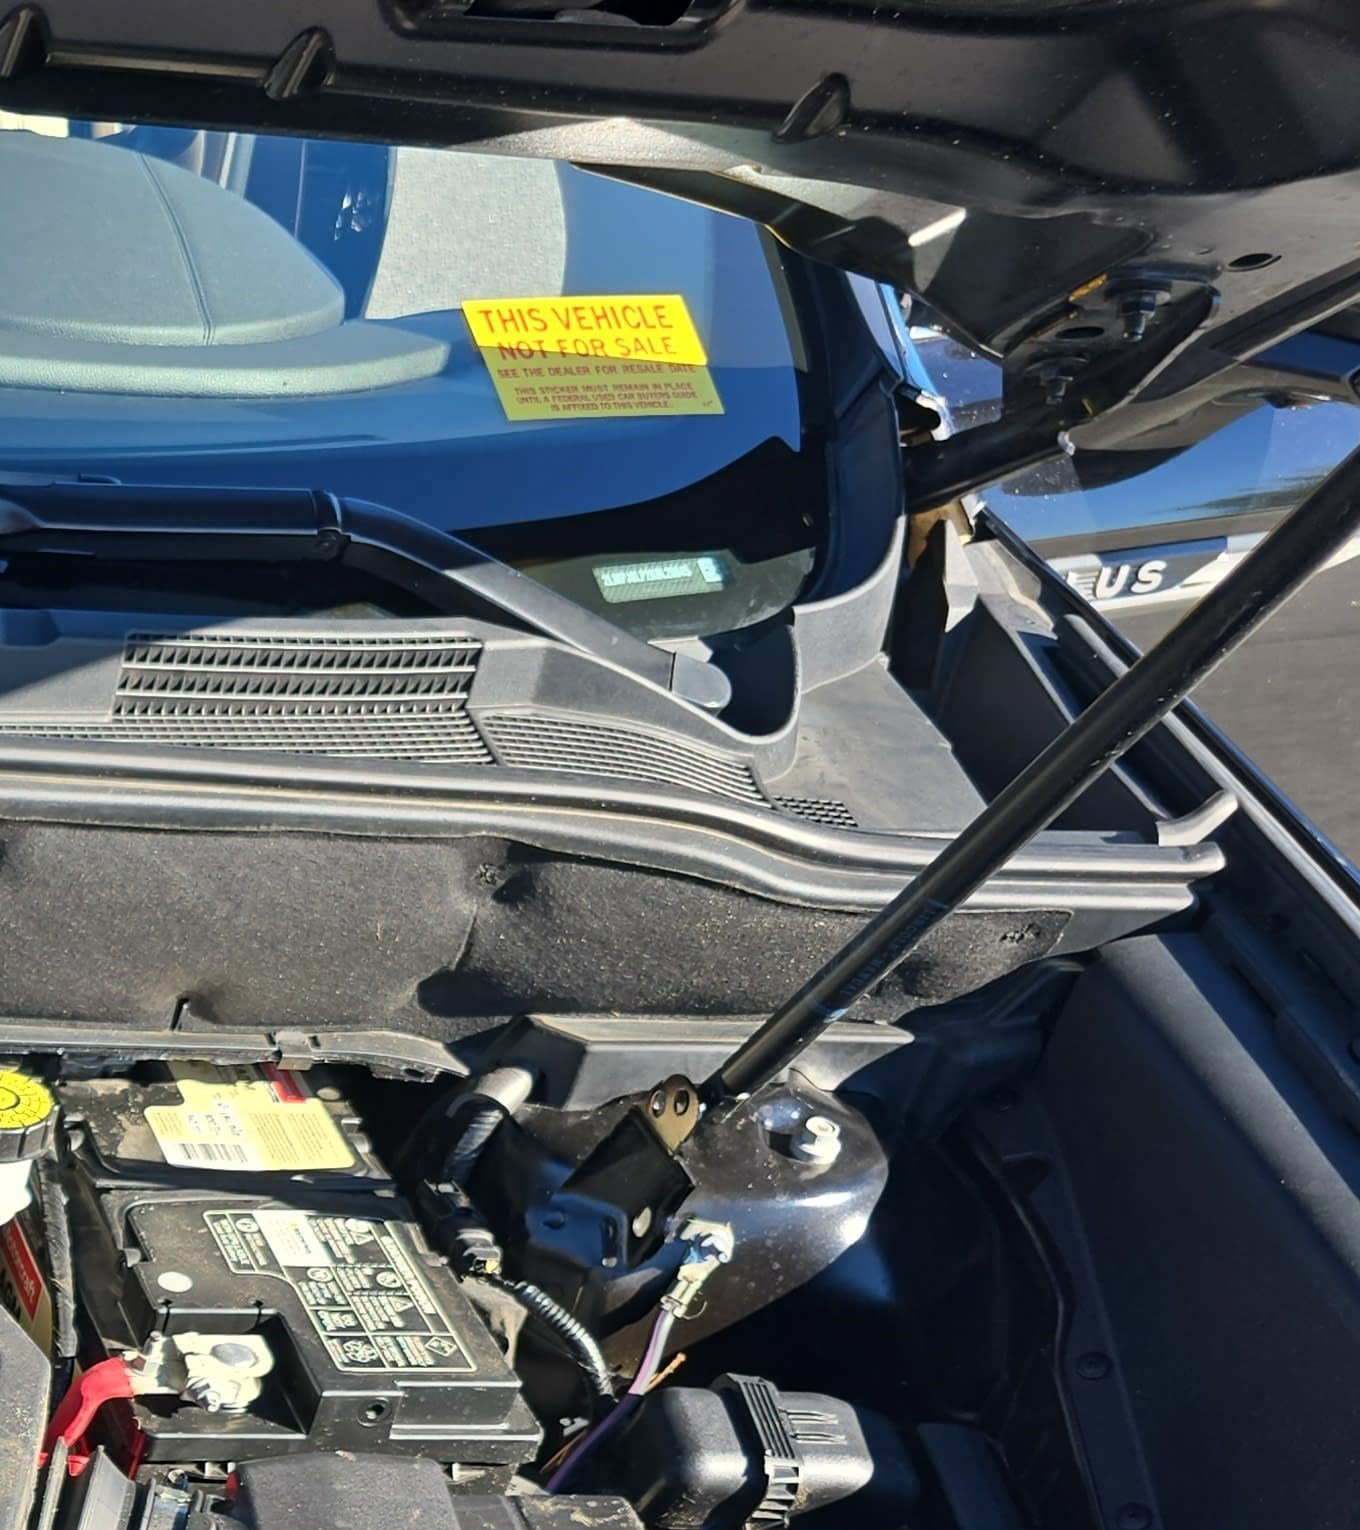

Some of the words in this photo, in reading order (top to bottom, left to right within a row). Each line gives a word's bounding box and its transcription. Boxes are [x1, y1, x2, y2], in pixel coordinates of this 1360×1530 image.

[479, 308, 548, 333] THIS
[551, 305, 673, 331] VEHICLE
[497, 340, 548, 360] NOT
[556, 338, 608, 358] FOR
[615, 336, 677, 358] SALE
[497, 369, 520, 378] SEE
[522, 367, 544, 377] THE
[548, 366, 590, 376] DEALER
[595, 365, 617, 375] FOR
[622, 364, 663, 374] RESALE
[668, 363, 697, 373] DATE
[514, 387, 536, 395] THIS
[538, 386, 578, 394] STICKER
[612, 384, 650, 392] REMAIN
[664, 382, 693, 390] PLACE
[515, 396, 542, 404] UNTIL
[552, 395, 593, 403] FEDERAL
[617, 392, 635, 400] CAR
[671, 390, 697, 398] GUIDE
[562, 403, 600, 411] AFFIXED
[612, 401, 633, 409] THIS
